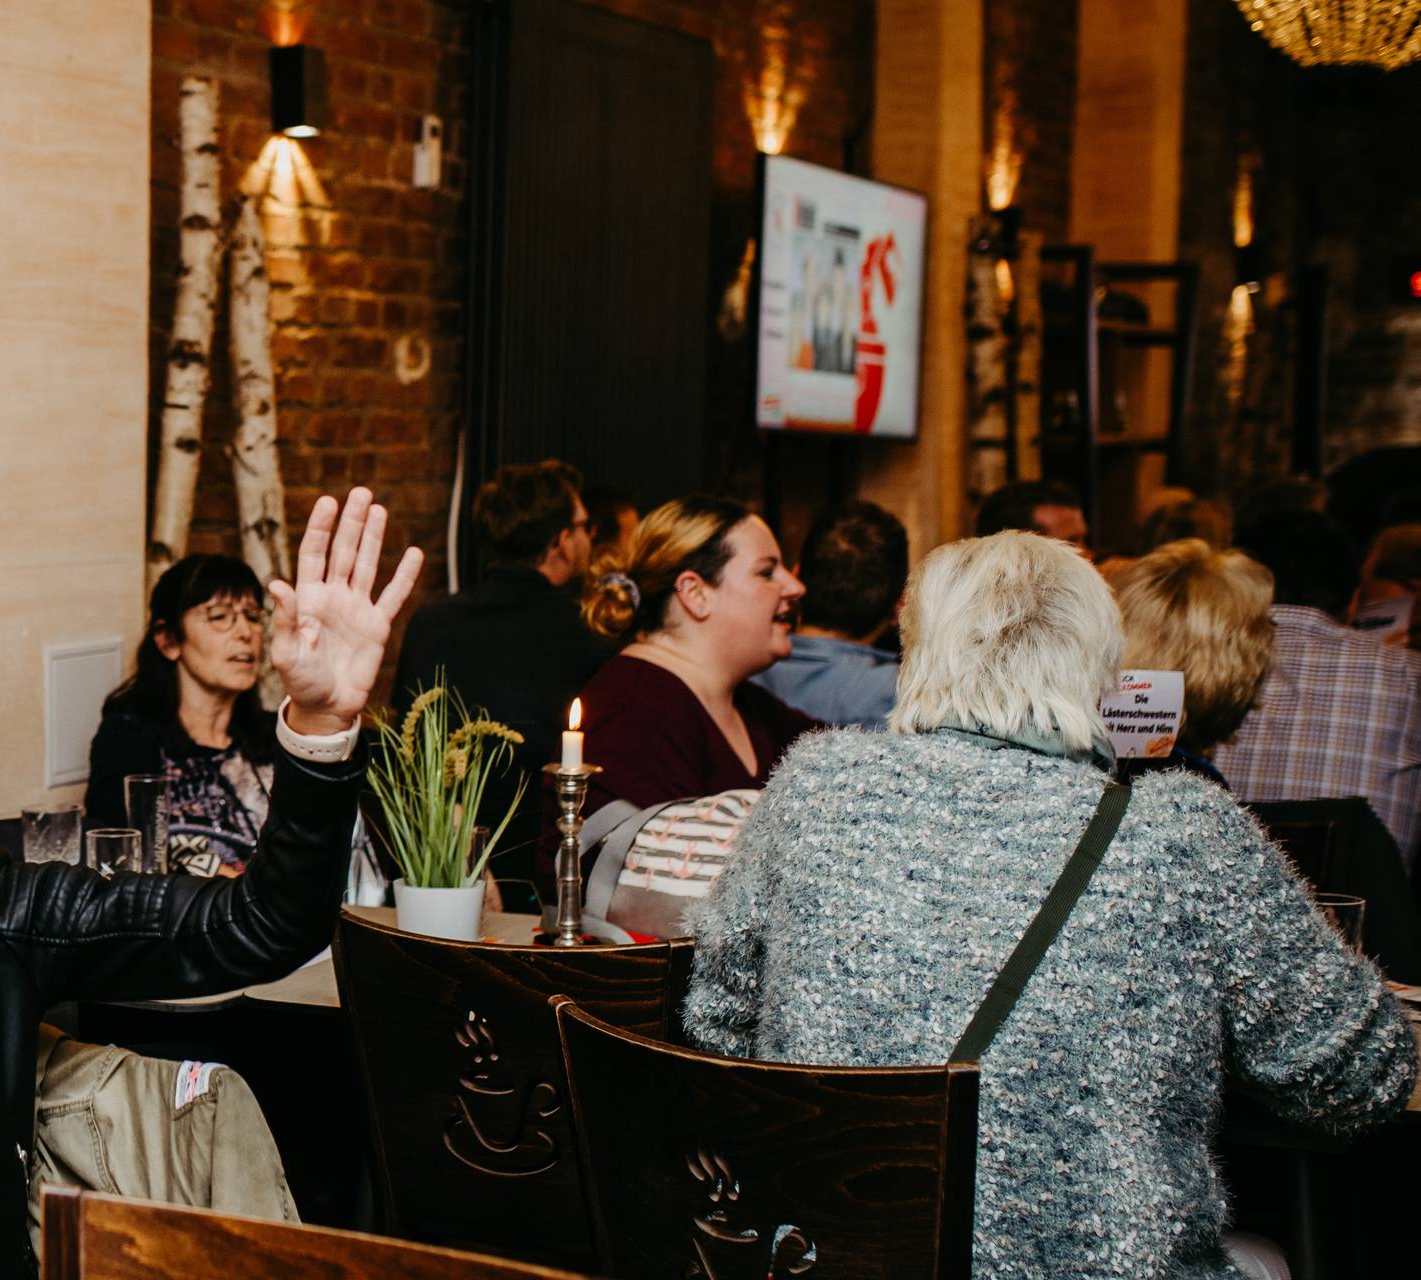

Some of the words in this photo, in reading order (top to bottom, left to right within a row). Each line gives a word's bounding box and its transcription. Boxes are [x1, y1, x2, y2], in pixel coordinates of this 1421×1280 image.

[1134, 693, 1149, 704] Die
[1102, 707, 1177, 719] Lästerschwestern
[1116, 722, 1136, 733] Herz
[1138, 723, 1155, 734] und
[1155, 723, 1175, 734] Hirn
